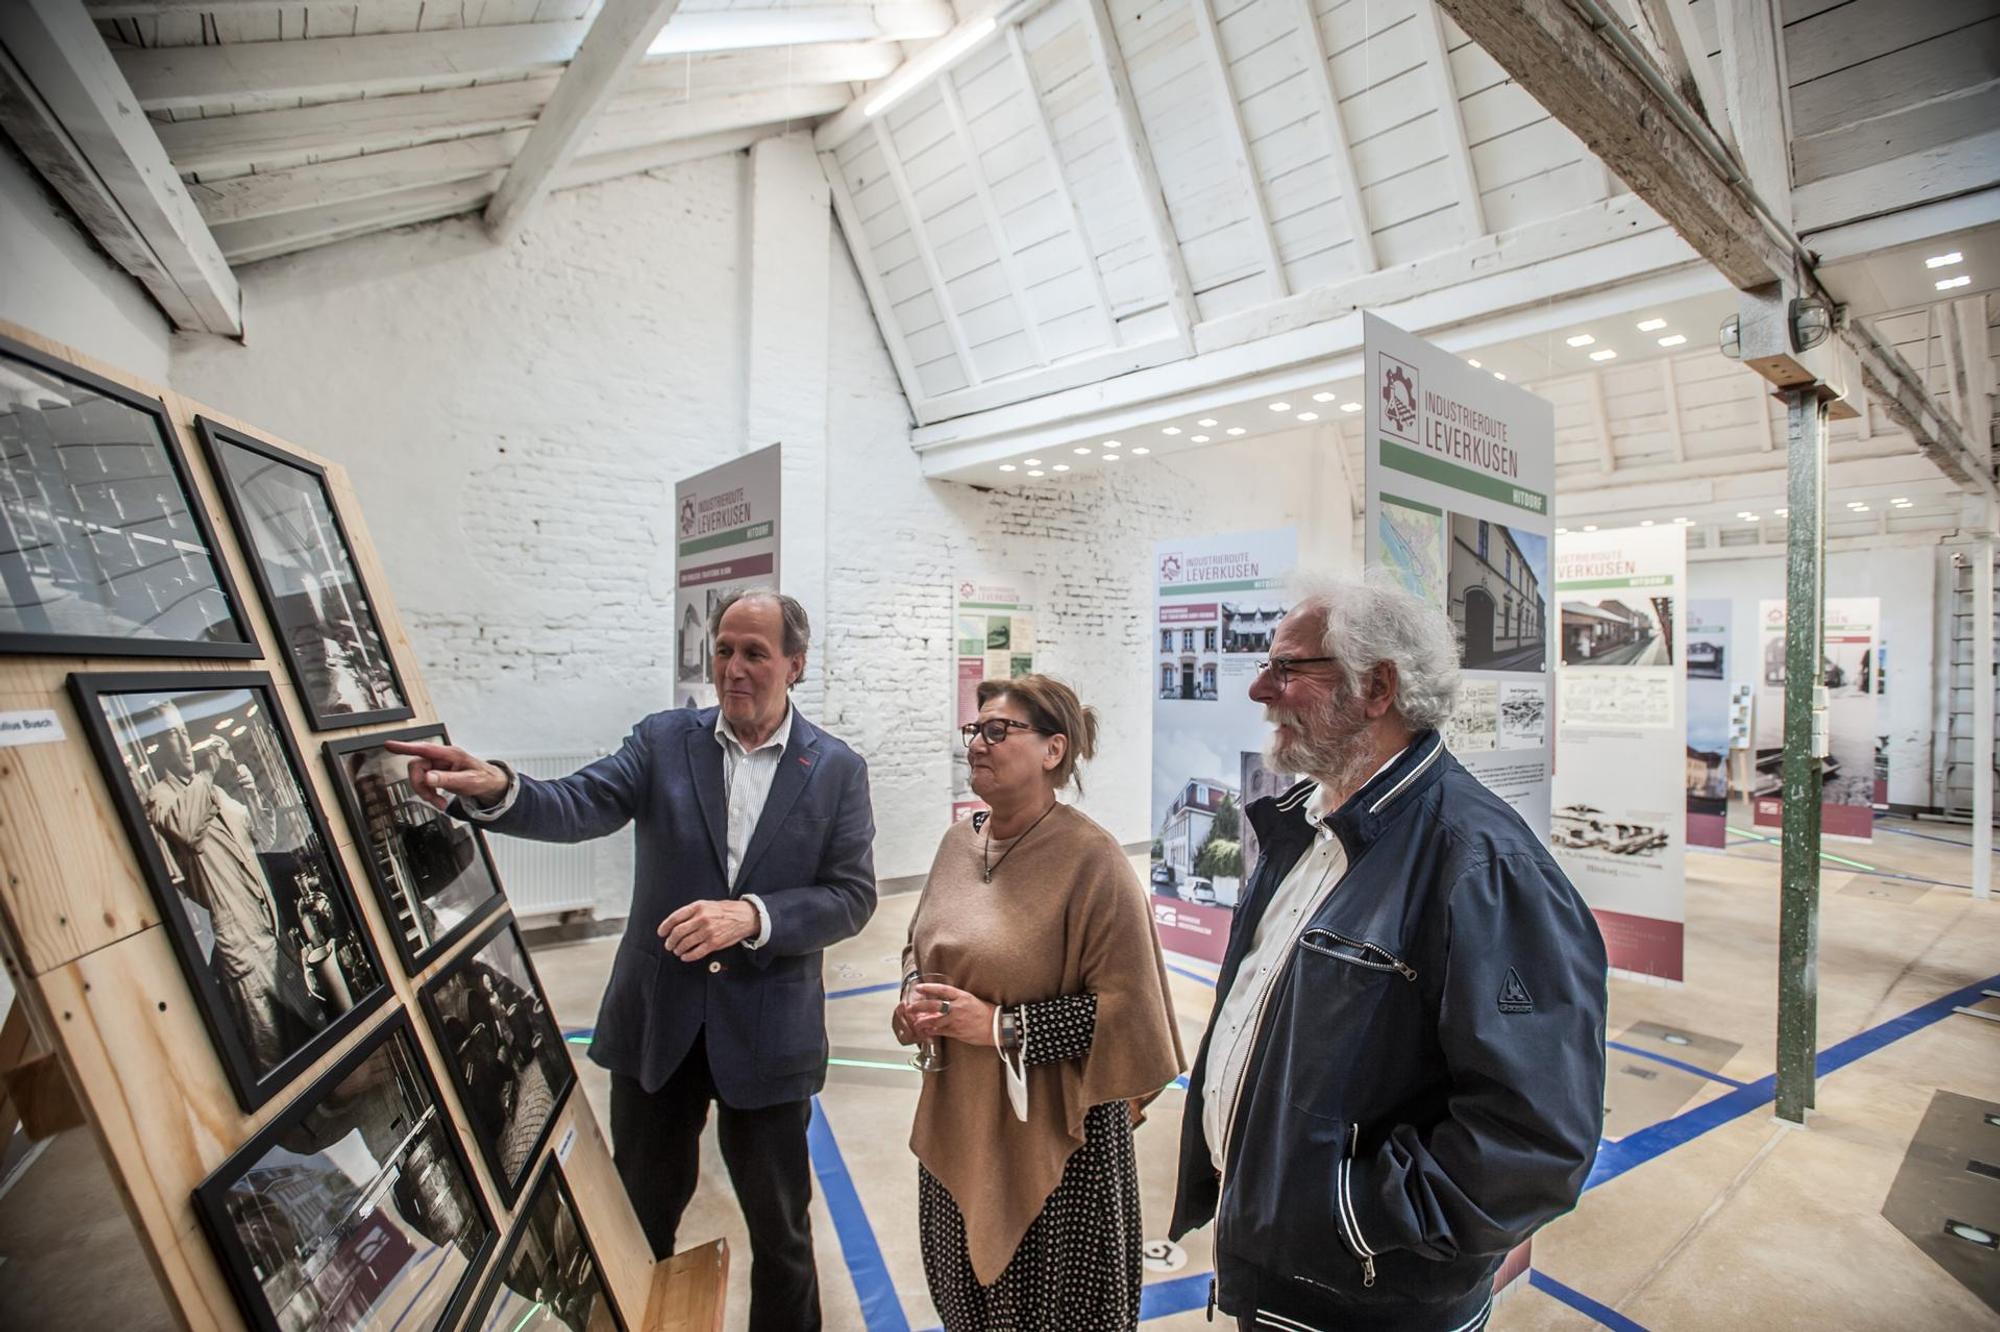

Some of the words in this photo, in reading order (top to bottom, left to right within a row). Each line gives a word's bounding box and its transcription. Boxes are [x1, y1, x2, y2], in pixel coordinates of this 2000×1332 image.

[1424, 390, 1508, 443] INDUSTRIEROUTE
[1425, 417, 1518, 479] LEVERKUSEN
[698, 502, 752, 535] LEVERKUSEN
[1185, 552, 1250, 567] INDUSTRIEROUTE
[1558, 560, 1636, 578] VERKUSEN
[1186, 563, 1259, 582] LEVERKUSEN
[0, 720, 22, 730] ulius
[22, 718, 53, 729] Busch
